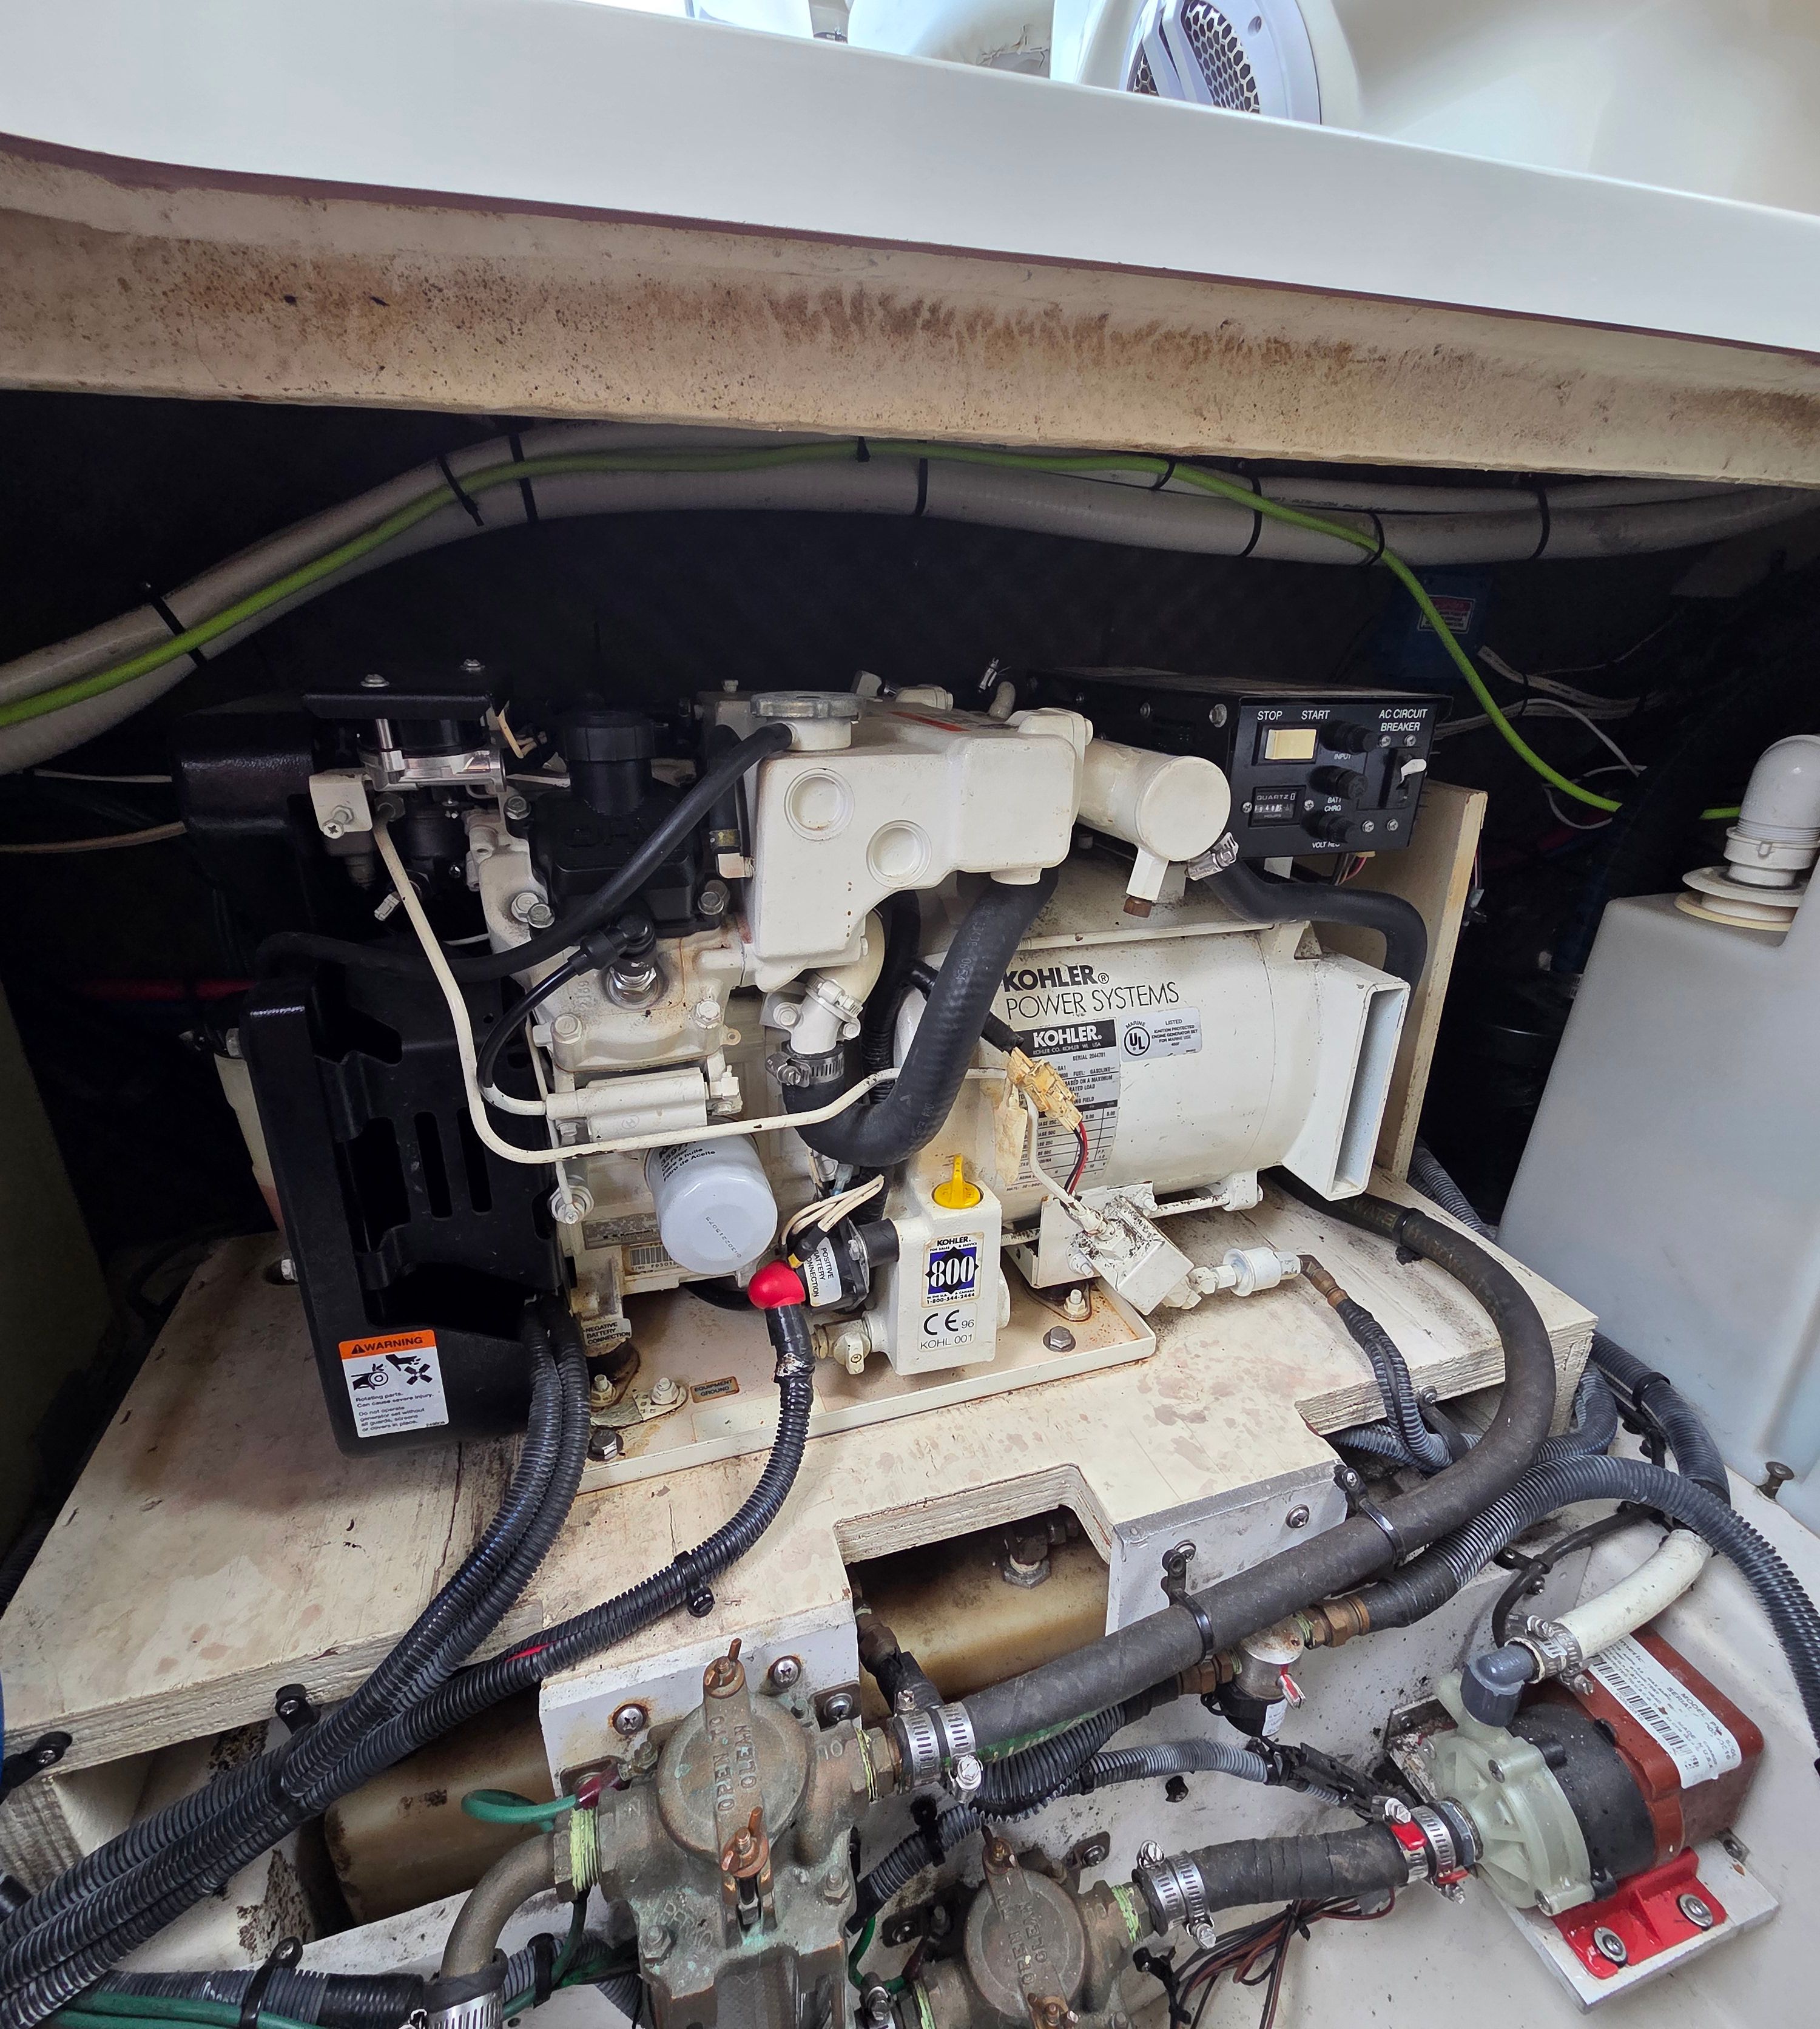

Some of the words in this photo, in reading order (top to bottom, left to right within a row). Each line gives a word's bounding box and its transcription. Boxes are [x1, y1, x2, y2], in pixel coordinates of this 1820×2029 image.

[1257, 711, 1282, 721] STOP
[1301, 710, 1330, 720] START
[1378, 709, 1392, 718] AC
[1393, 709, 1428, 718] CIRCUIT
[1381, 722, 1420, 732] BREAKER
[1006, 993, 1087, 1020] POWER
[1092, 981, 1179, 1012] SYSTEMS
[1125, 1020, 1146, 1029] MARINE
[1129, 1034, 1146, 1050] UL
[1091, 1075, 1113, 1083] MAXIMUM
[684, 1148, 703, 1158] huile
[691, 1150, 716, 1160] Aceite
[821, 1247, 834, 1280] POSITIVE
[806, 1257, 820, 1297] ONNECTION
[930, 1255, 975, 1288] 800
[926, 1292, 976, 1305] 1-800-544-2444
[585, 1322, 618, 1332] NEGATIVE
[961, 1319, 974, 1329] 96
[587, 1328, 616, 1339] BATTERY
[587, 1332, 631, 1345] CONNECTION
[364, 1337, 423, 1351] WARNING
[920, 1339, 951, 1349] KOHL
[954, 1334, 972, 1345] 001
[694, 1379, 733, 1392] EQUIPMENT
[700, 1386, 730, 1396] GROUND
[360, 1414, 389, 1422] generator
[733, 1724, 757, 1789] CLEAN
[712, 1752, 735, 1812] OPEN
[1020, 1902, 1048, 1963] CLEAN
[1008, 1931, 1036, 1985] OPEN
